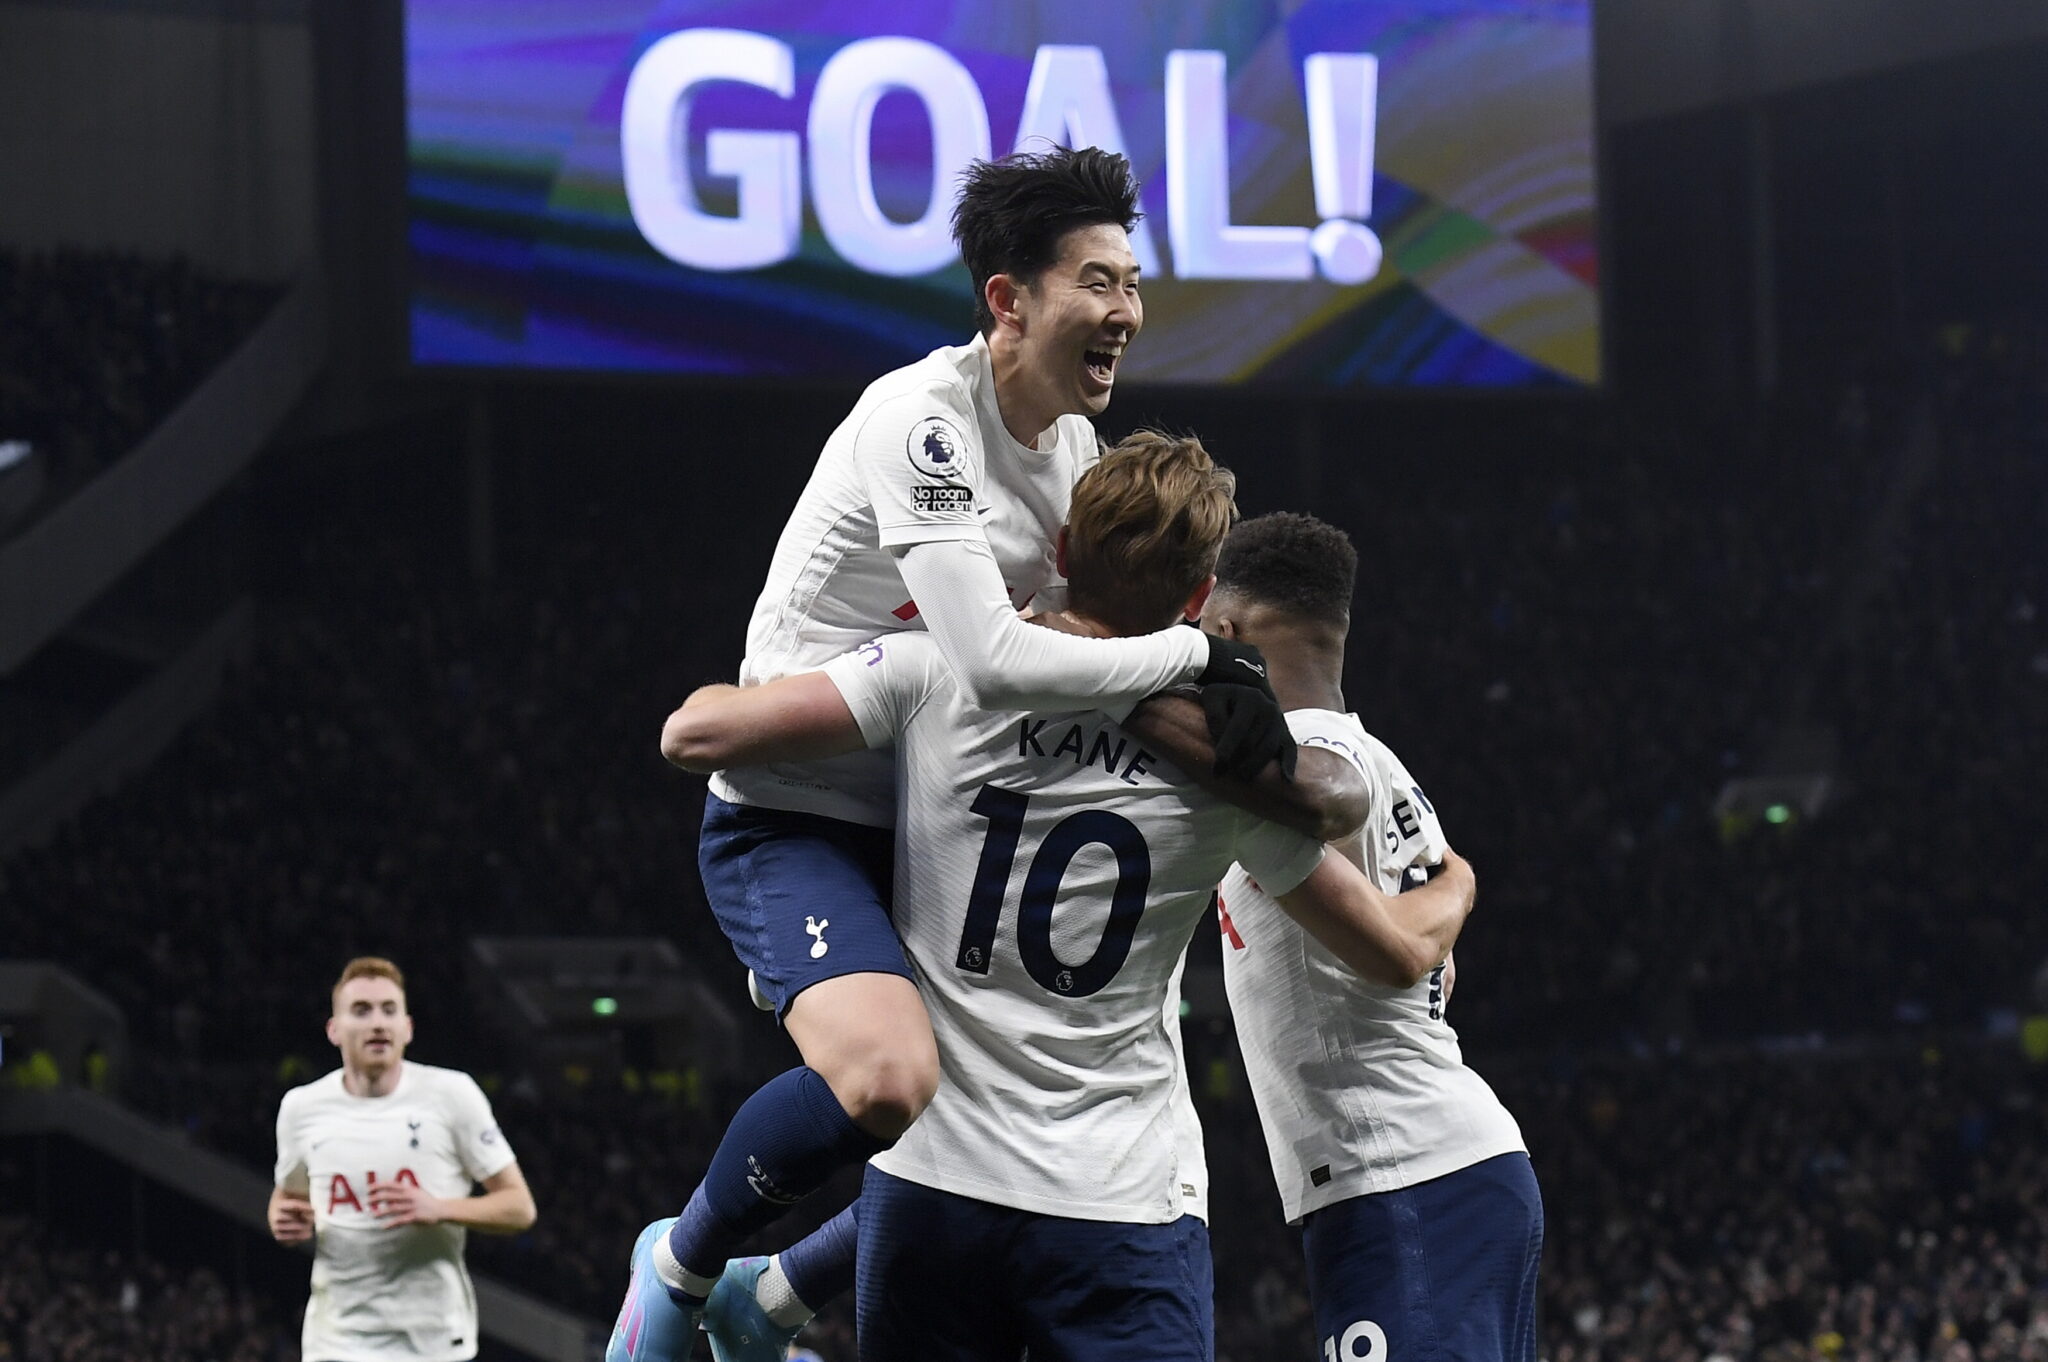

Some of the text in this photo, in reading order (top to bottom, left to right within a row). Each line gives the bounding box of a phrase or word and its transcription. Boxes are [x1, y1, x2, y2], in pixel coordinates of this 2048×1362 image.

[911, 487, 968, 500] No room
[1018, 719, 1157, 786] KANE
[956, 783, 1151, 998] 10
